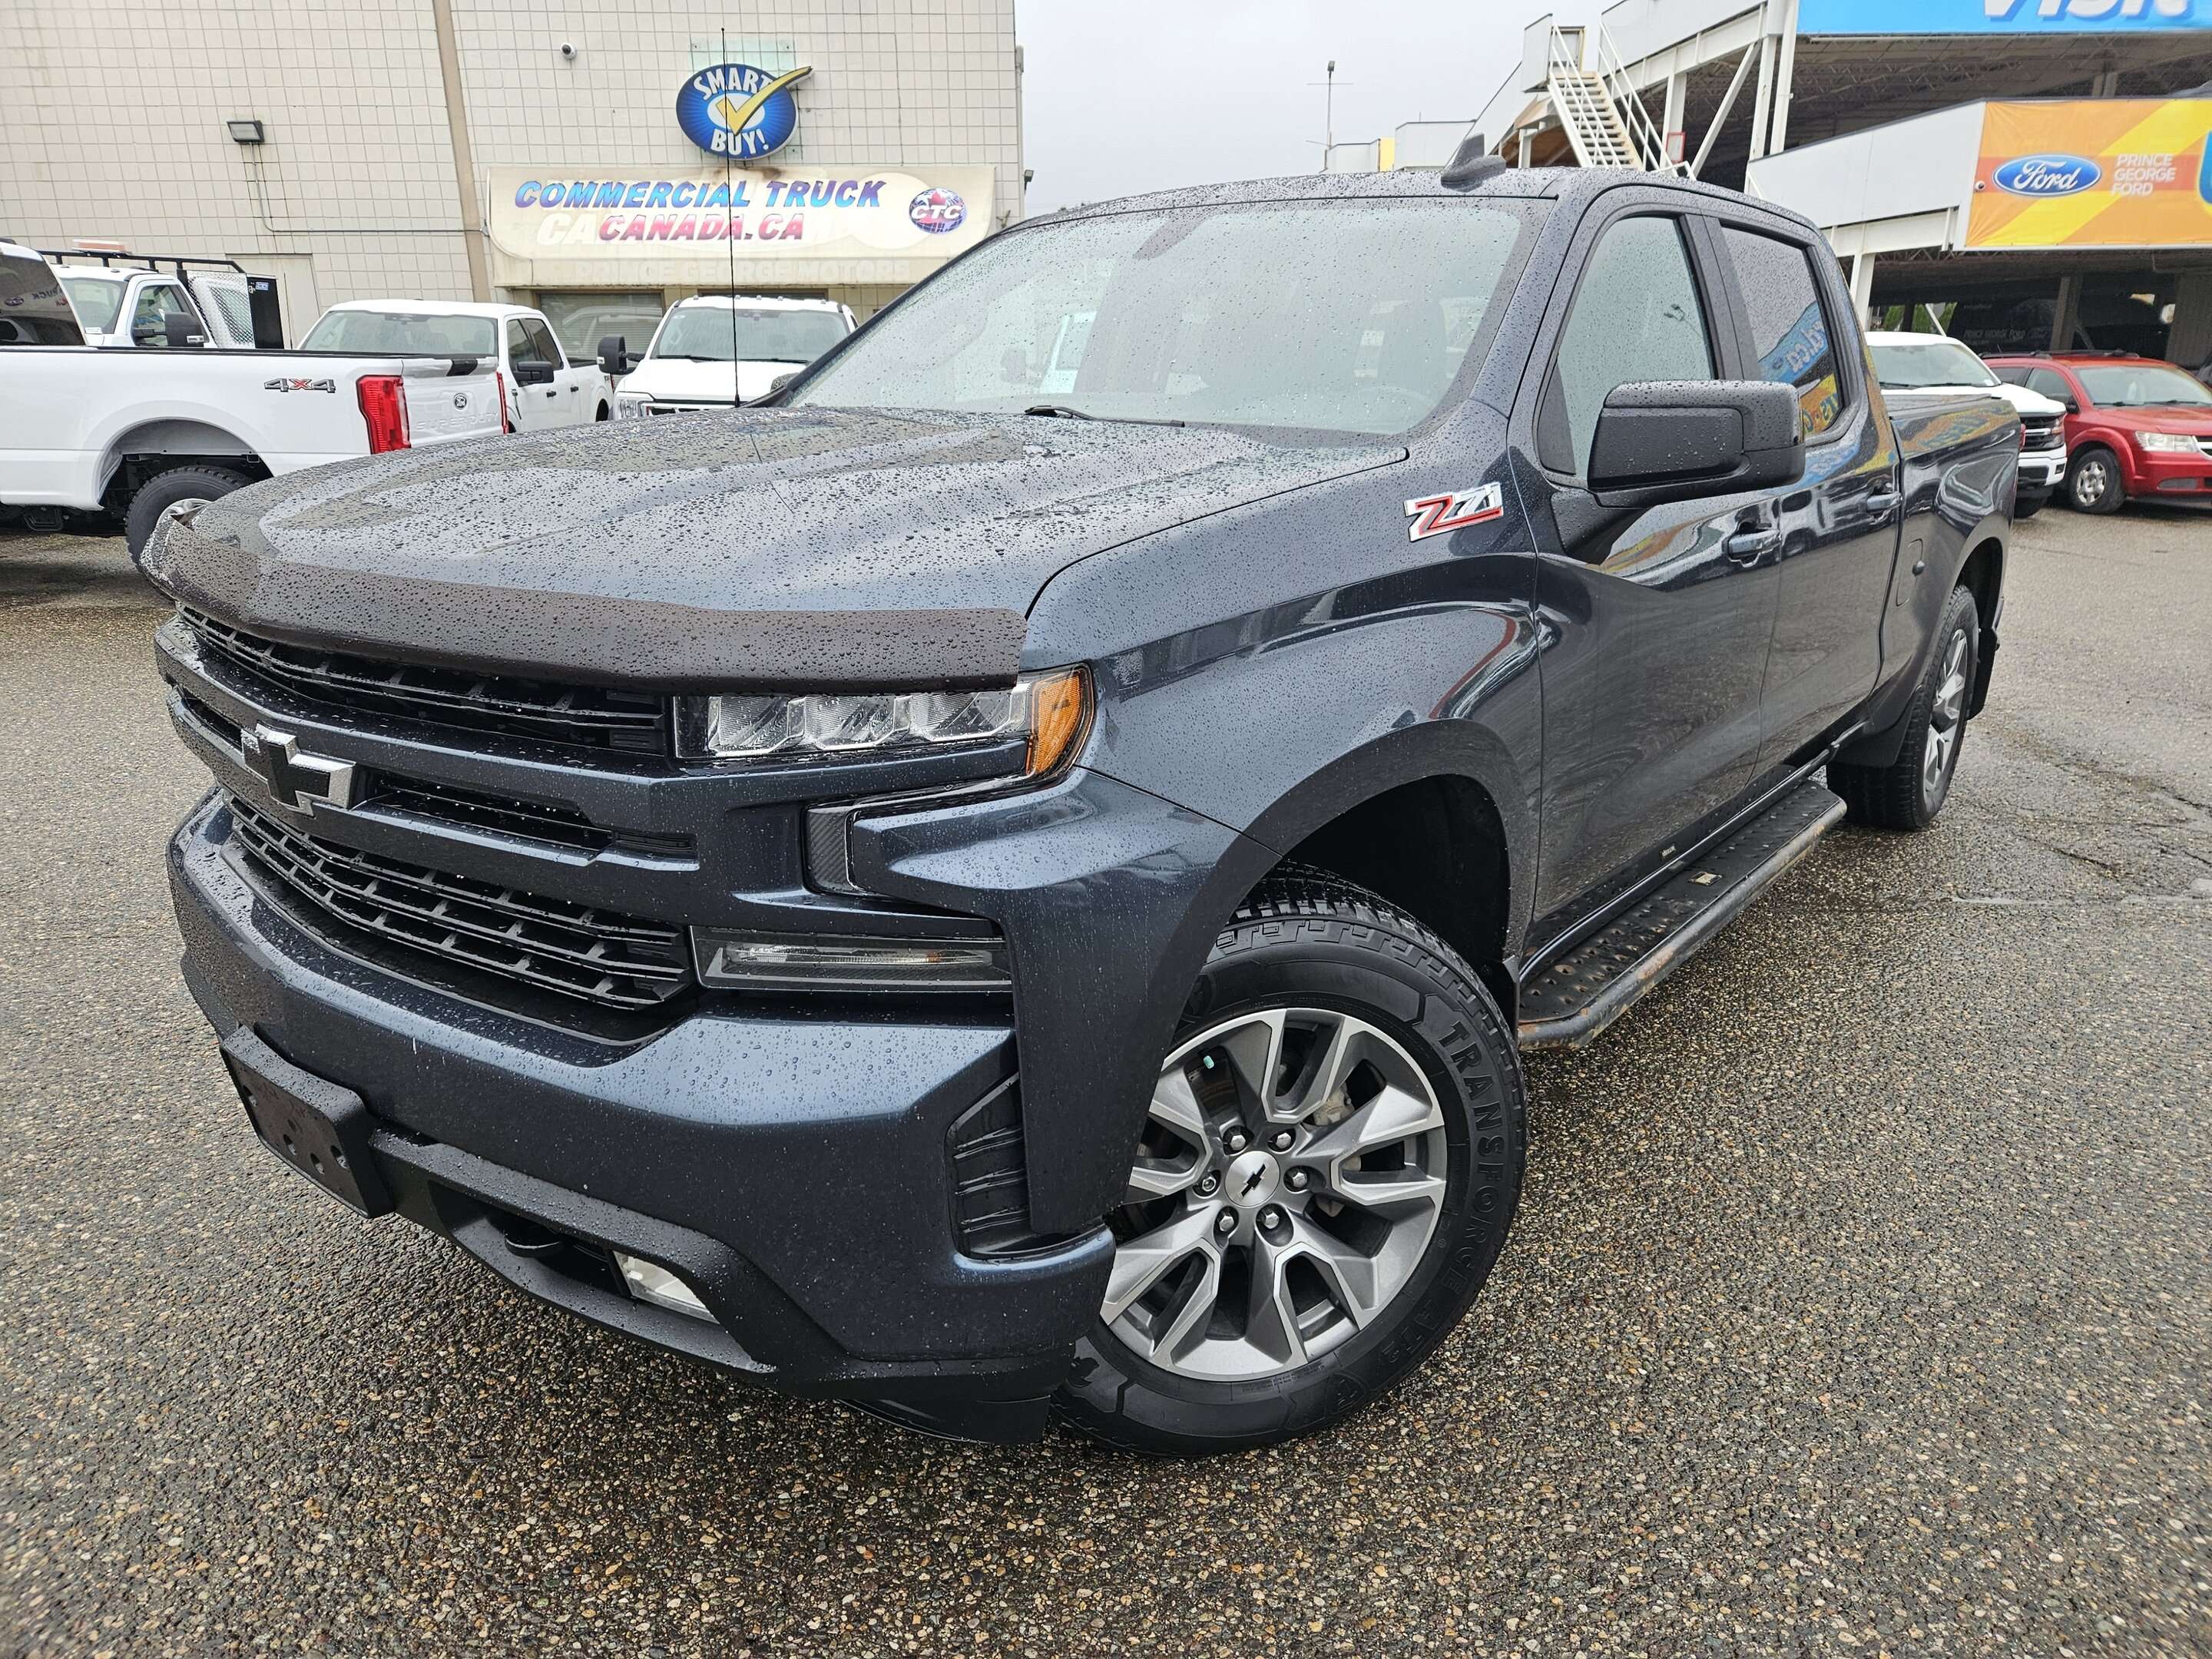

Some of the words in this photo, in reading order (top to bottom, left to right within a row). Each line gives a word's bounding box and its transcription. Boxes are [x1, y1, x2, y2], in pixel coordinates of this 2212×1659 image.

[694, 67, 774, 101] SMART
[710, 128, 769, 155] BUY!
[2114, 167, 2177, 181] GEORGE
[2116, 154, 2173, 167] PRINCE
[2014, 160, 2081, 190] Ford
[515, 180, 750, 208] COMMERCIAL
[767, 180, 887, 208] TRUCK
[2111, 182, 2154, 197] FORD
[911, 204, 962, 220] CTC
[598, 213, 804, 241] CANADA.CA
[1404, 482, 1503, 542] Z71
